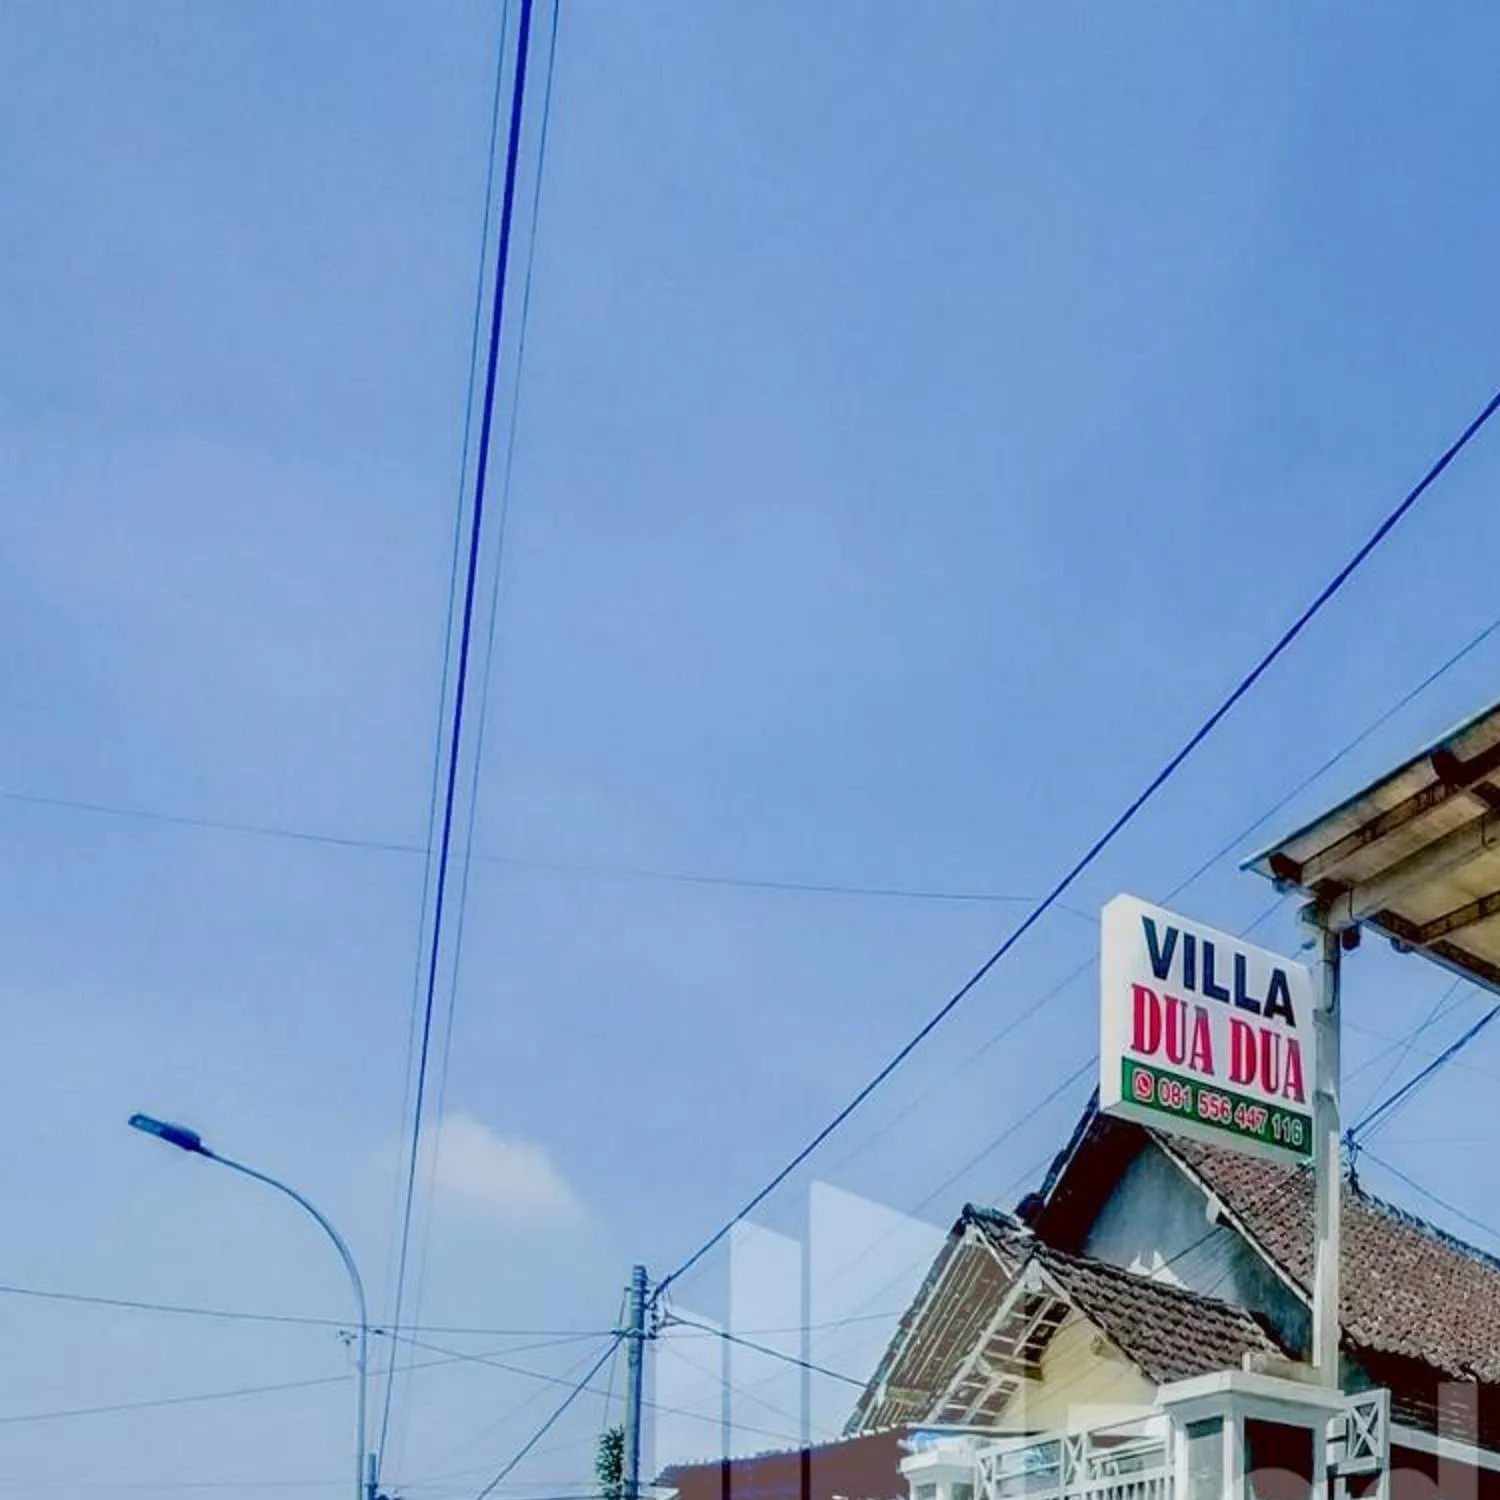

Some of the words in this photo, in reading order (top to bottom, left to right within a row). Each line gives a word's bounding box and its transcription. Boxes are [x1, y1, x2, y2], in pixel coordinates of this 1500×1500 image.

[1142, 915, 1296, 1028] VILLA
[1131, 983, 1215, 1076] DUA
[1229, 1017, 1306, 1105] DUA
[1158, 1078, 1192, 1112] 081
[1198, 1090, 1232, 1124] 556
